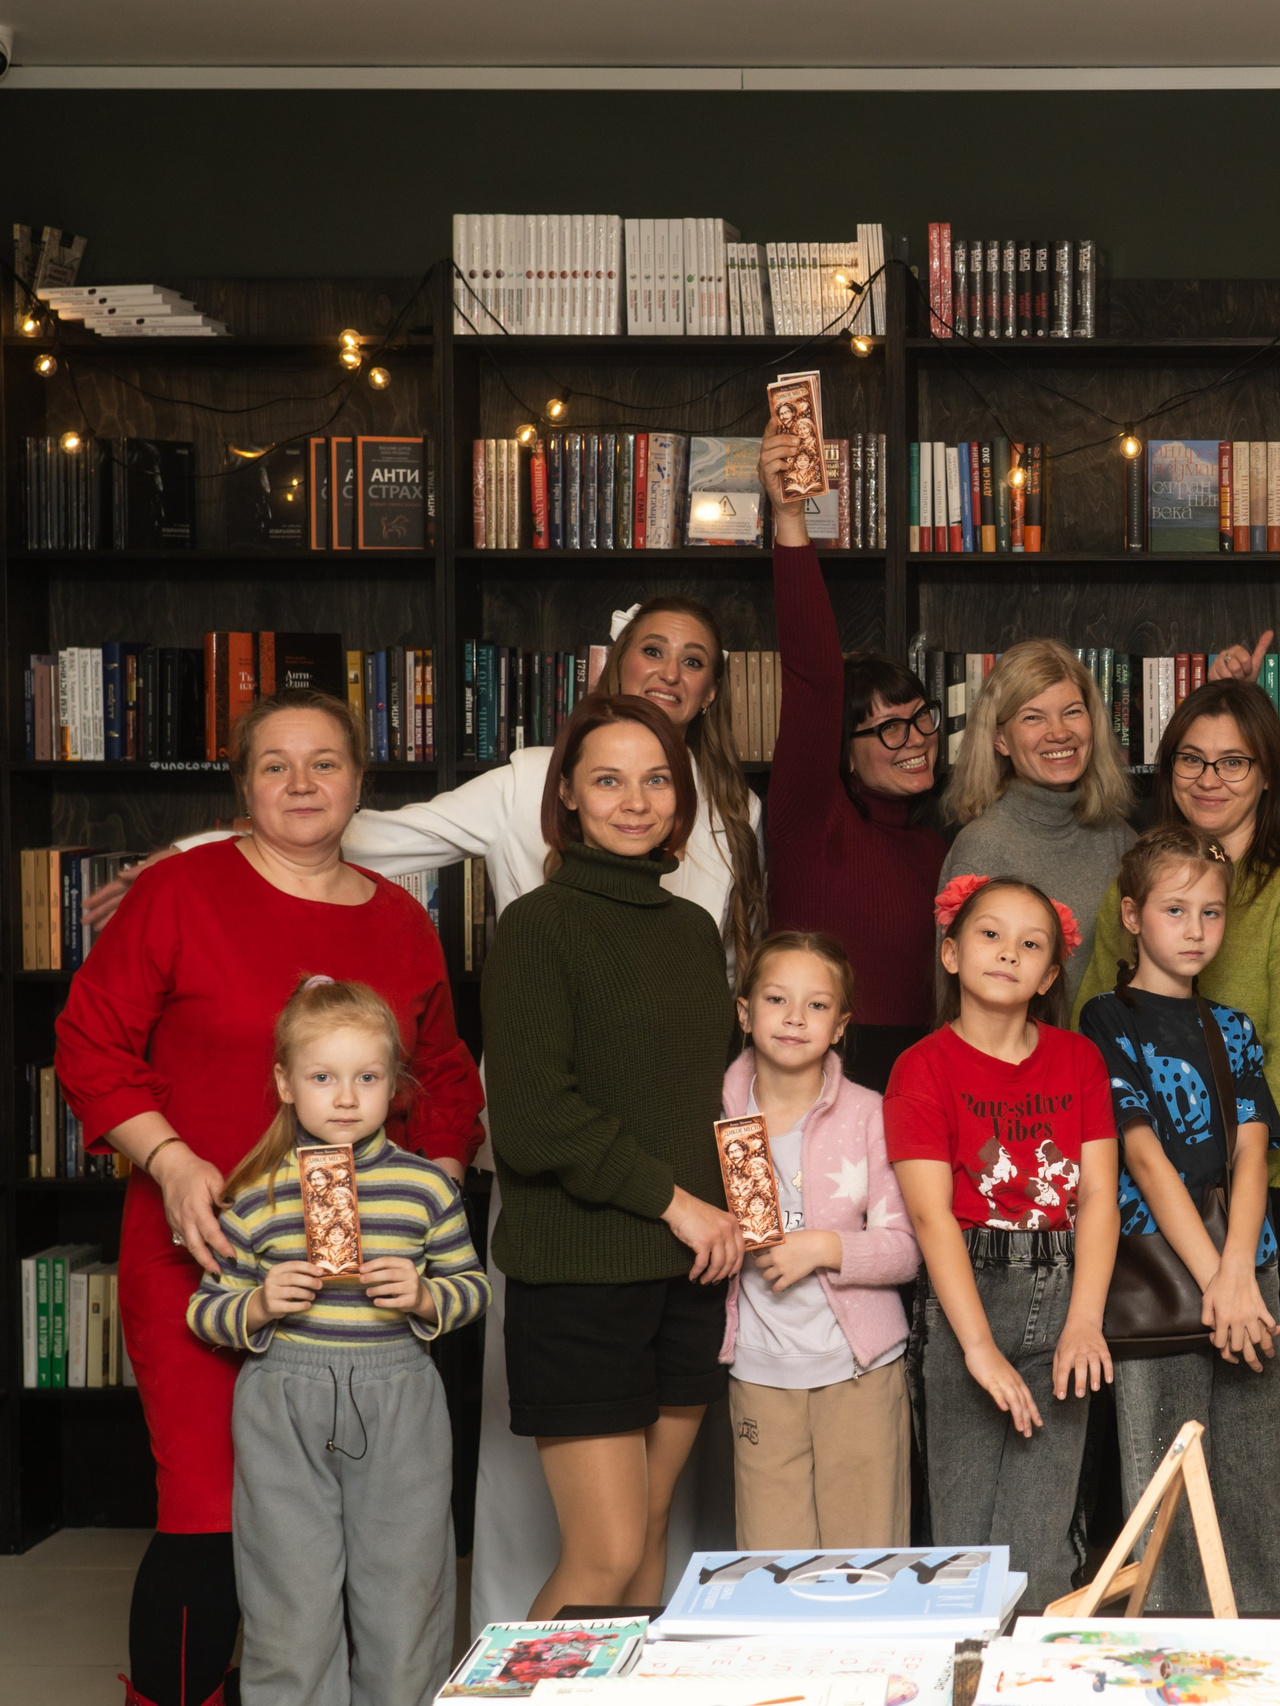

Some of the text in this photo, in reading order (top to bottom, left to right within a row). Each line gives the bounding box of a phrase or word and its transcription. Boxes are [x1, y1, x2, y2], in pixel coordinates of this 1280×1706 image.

[851, 447, 861, 471] 1793
[370, 468, 420, 483] АНТИ
[982, 446, 993, 497] ДУН СИ ЭХО
[368, 485, 423, 499] СТРАХ
[427, 470, 436, 517] АНТИСТРАХ
[1152, 481, 1213, 501] стран
[1241, 474, 1249, 523] АКИМИТИ
[637, 491, 645, 524] СЕМЬЯ
[648, 480, 656, 527] Кастамара
[1152, 505, 1193, 520] века
[285, 670, 312, 681] Анти-
[576, 659, 587, 682] 1793
[60, 655, 68, 718] ЧЕМ ИСТИНА?
[285, 679, 310, 689] Эдип
[391, 681, 400, 728] АНТИСТРАХ
[465, 687, 473, 711] ГОЛДИНГ
[465, 712, 473, 734] МЕЛАНИ
[960, 1092, 1074, 1119] Paw-sitive
[723, 1124, 761, 1137] ДИКОЕ МЕСТО
[992, 1117, 1053, 1142] Vibes
[307, 1156, 328, 1164] ДИКОЕ
